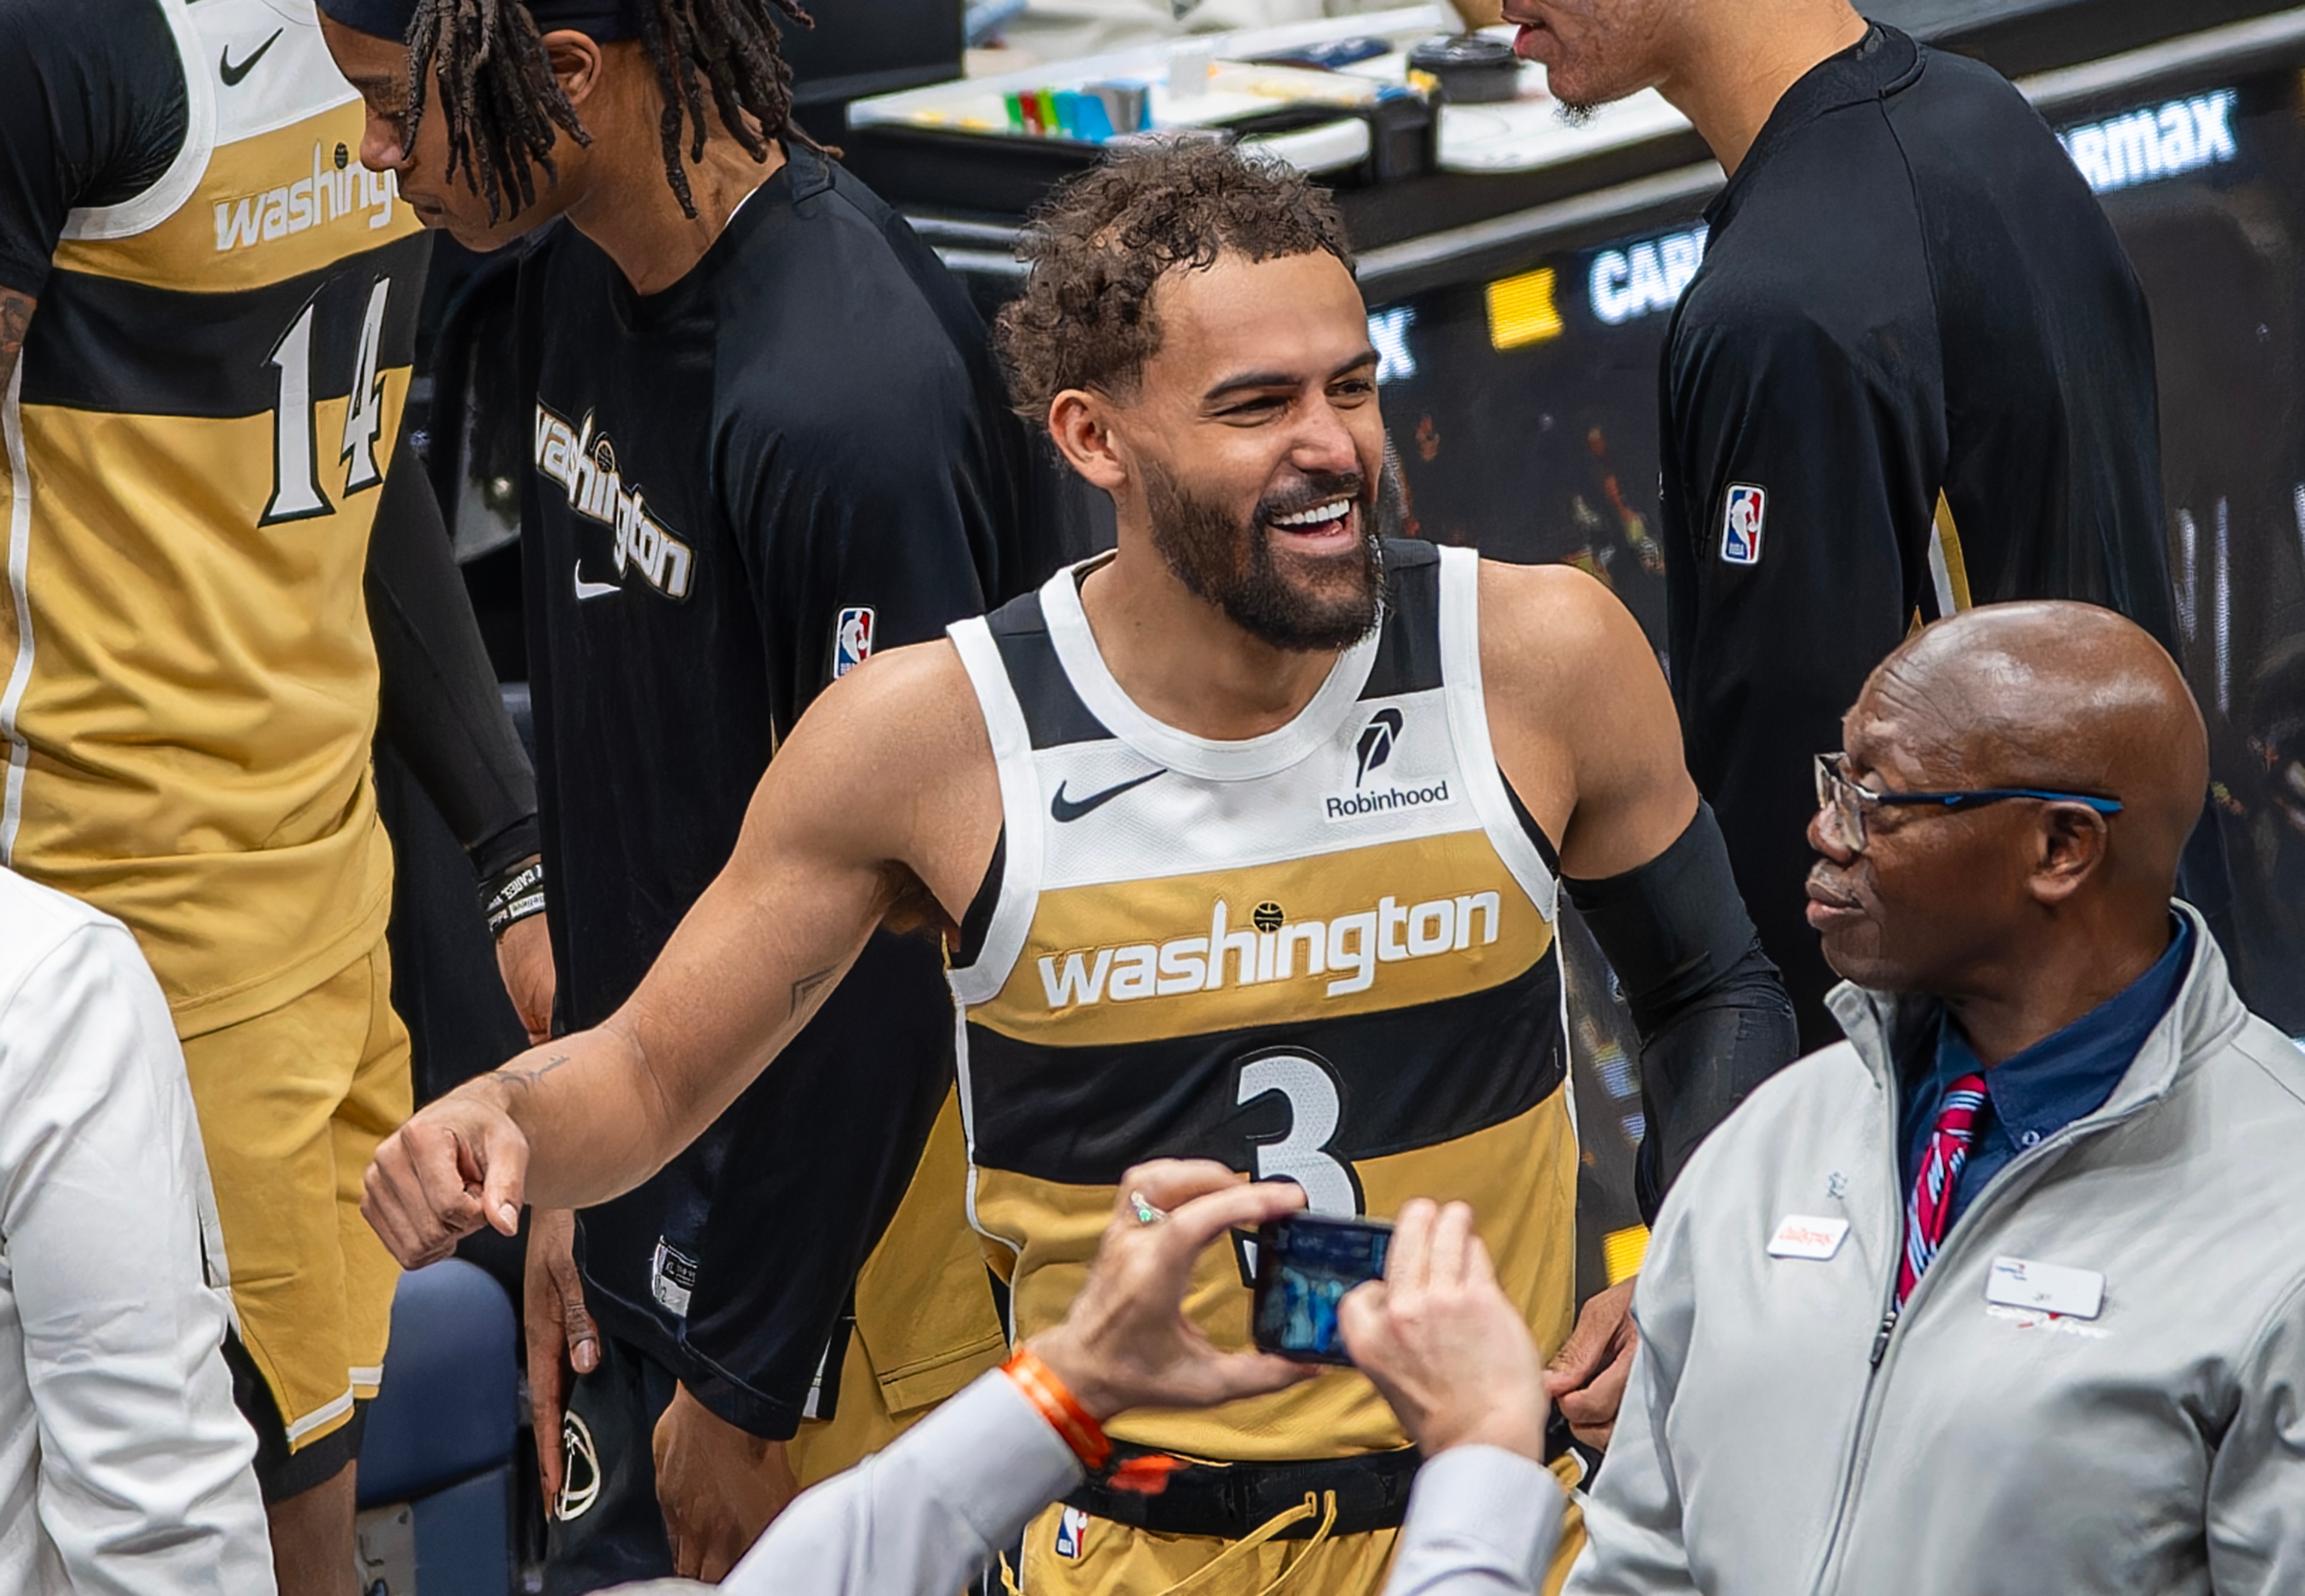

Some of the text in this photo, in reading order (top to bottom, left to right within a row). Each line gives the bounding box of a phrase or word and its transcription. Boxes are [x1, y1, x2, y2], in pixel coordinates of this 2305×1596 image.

[215, 140, 400, 251] washing
[259, 276, 389, 526] 14
[1326, 780, 1449, 818] Robinhood
[1037, 891, 1501, 1008] washington
[1235, 1053, 1359, 1279] 3
